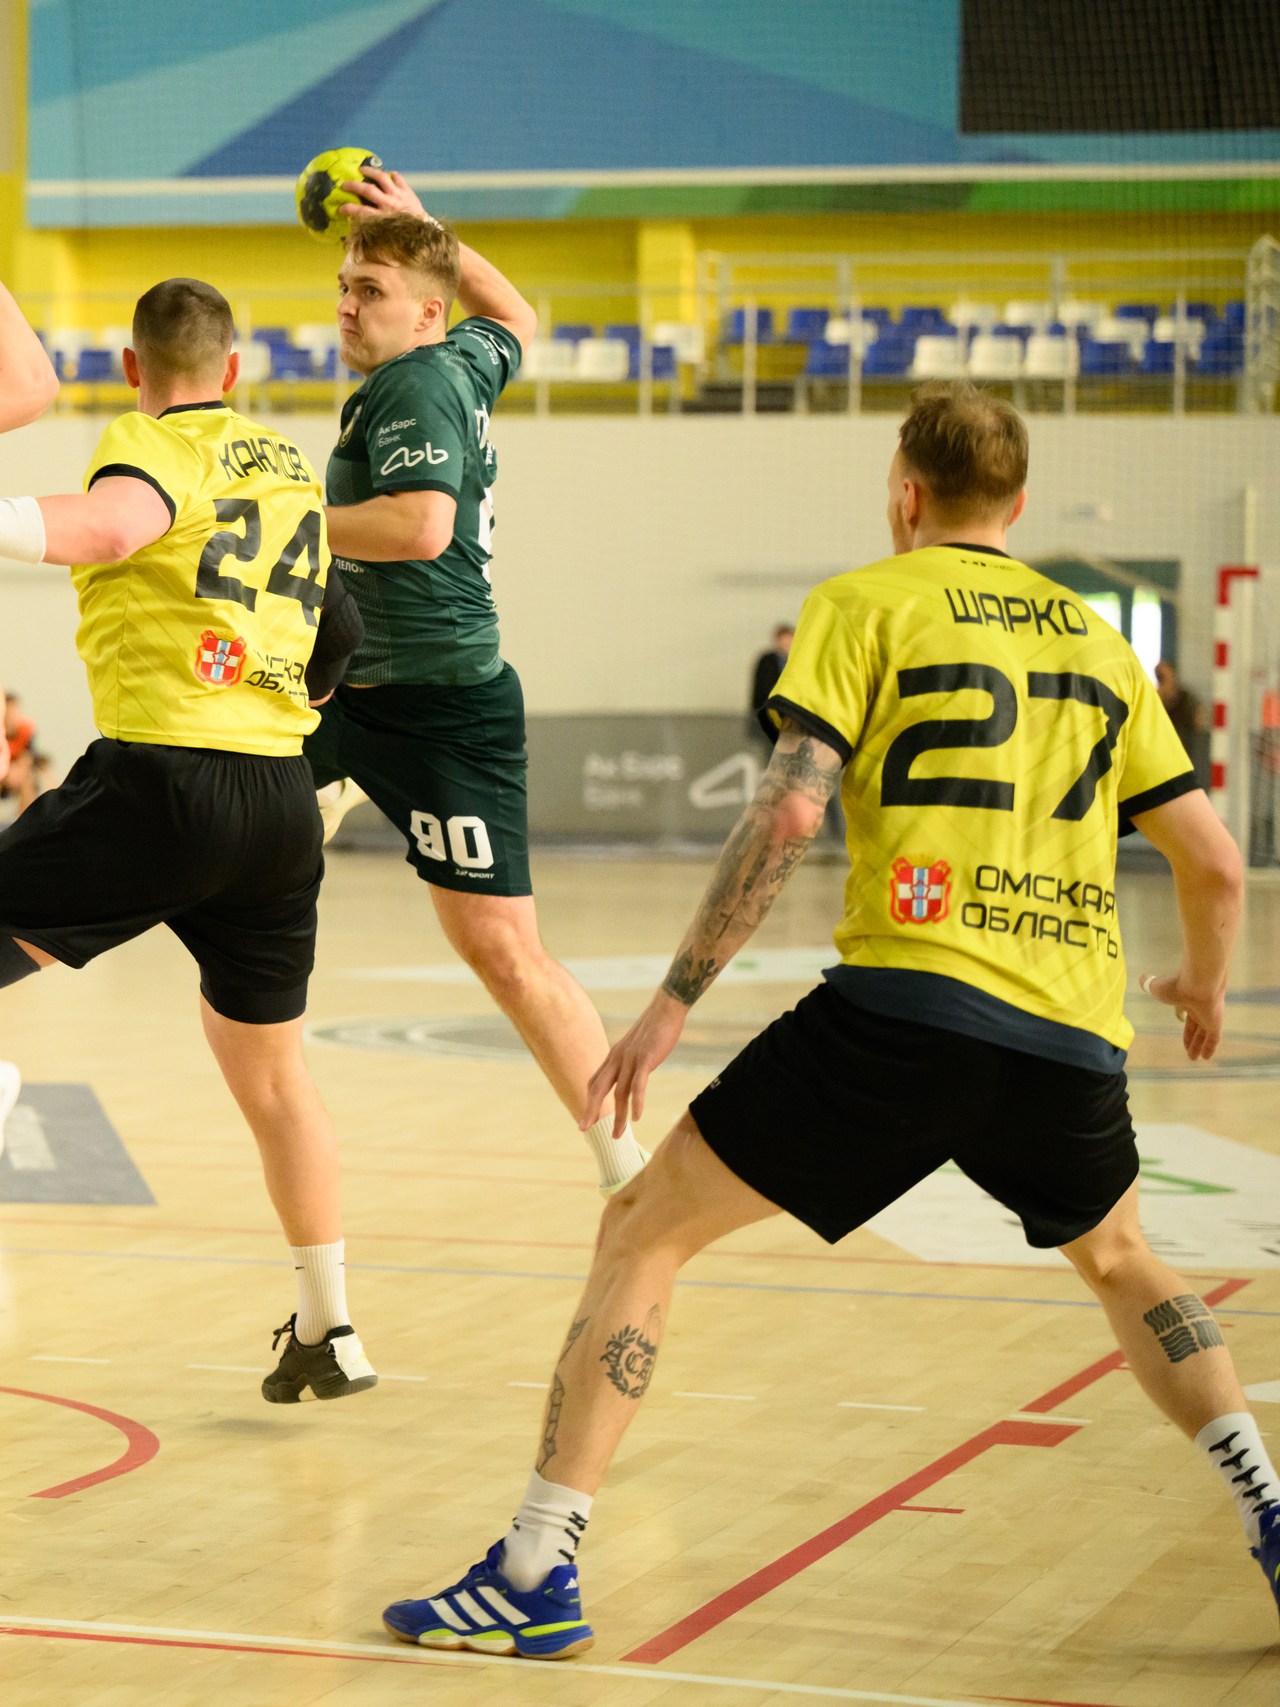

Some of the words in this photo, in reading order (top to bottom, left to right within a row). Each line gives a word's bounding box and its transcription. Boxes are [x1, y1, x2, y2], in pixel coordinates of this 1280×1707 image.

[378, 425, 391, 437] Ак
[392, 417, 417, 431] Барс
[378, 433, 402, 448] Банк
[195, 498, 325, 628] 24
[944, 588, 1088, 636] ШАРКО
[880, 662, 1129, 822] 27
[410, 810, 494, 869] 90
[975, 864, 1115, 920] ОМСКАЯ
[961, 902, 1118, 959] ОБЛАСТЬ
